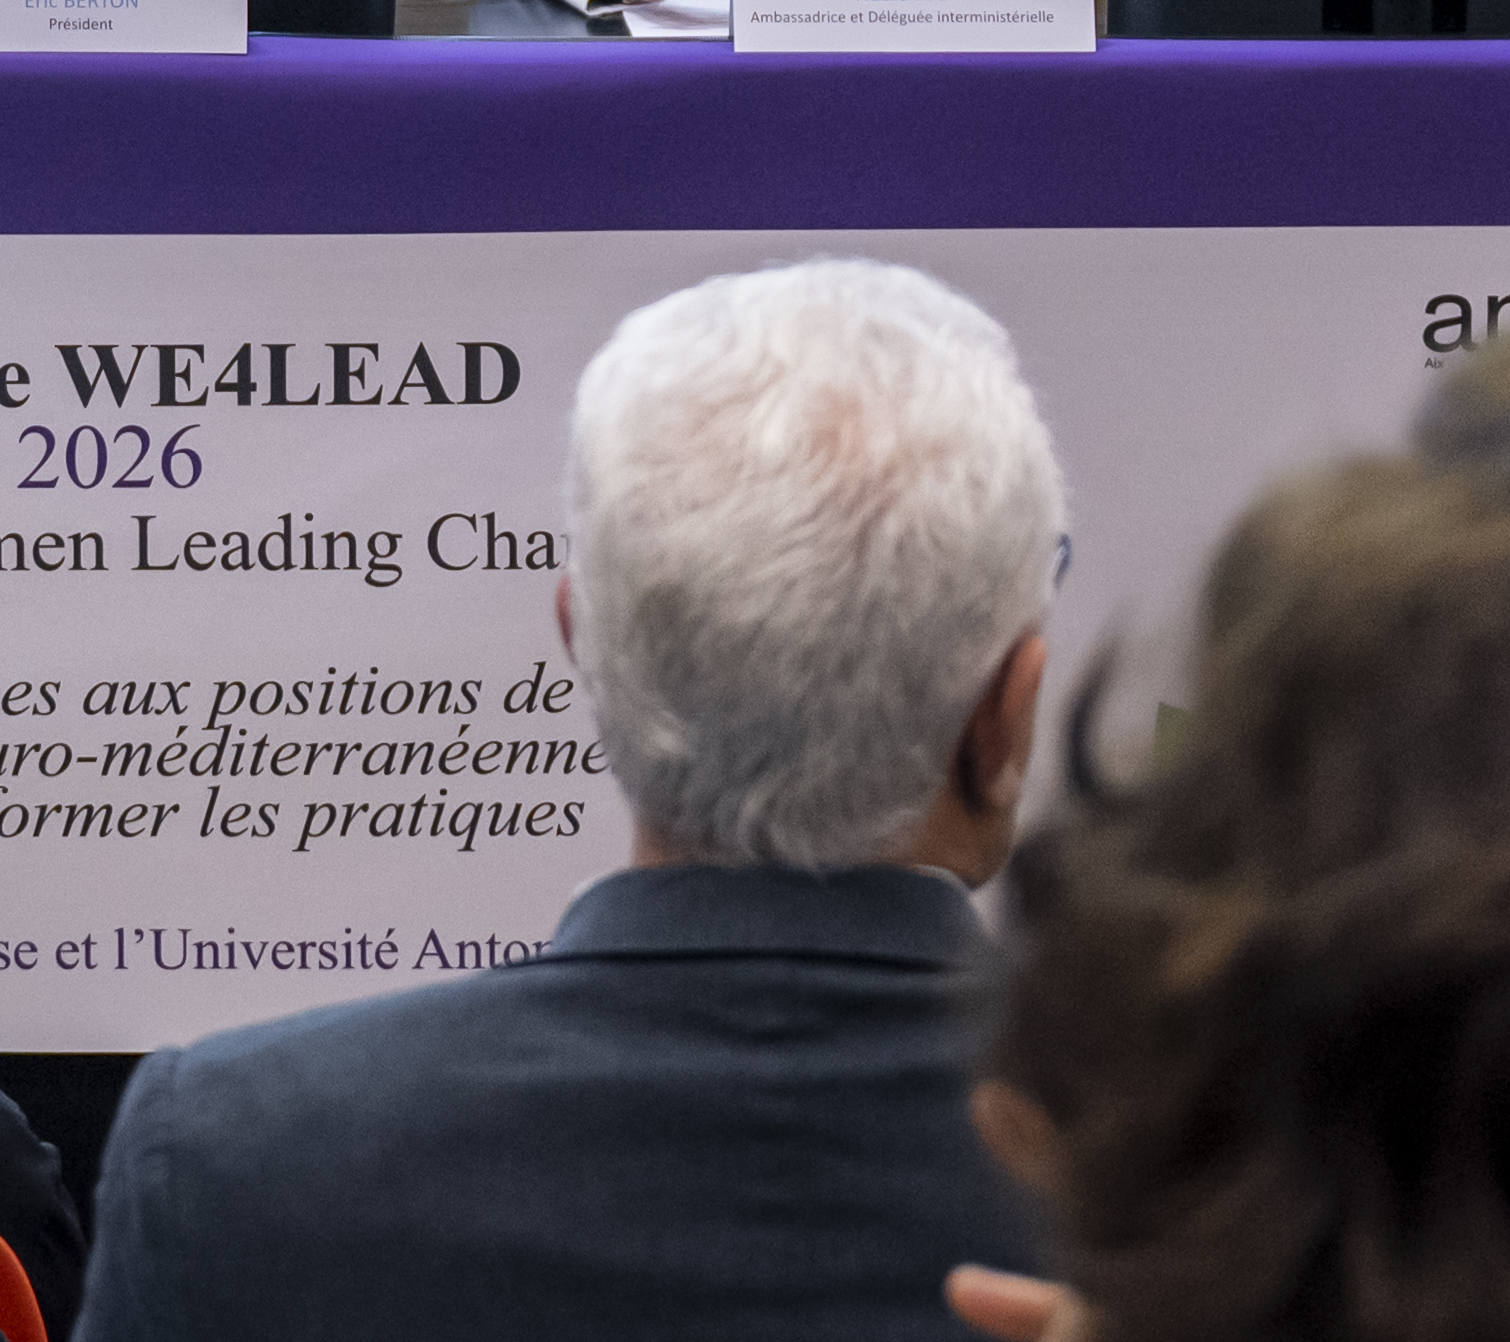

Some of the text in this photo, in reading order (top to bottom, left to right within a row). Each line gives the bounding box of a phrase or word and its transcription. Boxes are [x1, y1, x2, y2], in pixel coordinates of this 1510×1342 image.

[49, 17, 113, 30] Président
[750, 10, 1054, 26] Ambassadrice et Déléguée interministérielle
[54, 341, 522, 409] WE4LEAD
[16, 423, 203, 490] 2026
[131, 511, 403, 588] Leading
[82, 677, 190, 717] aux
[202, 664, 483, 731] positions
[503, 661, 574, 717] de
[200, 786, 585, 854] les pratiques
[55, 933, 99, 971] et
